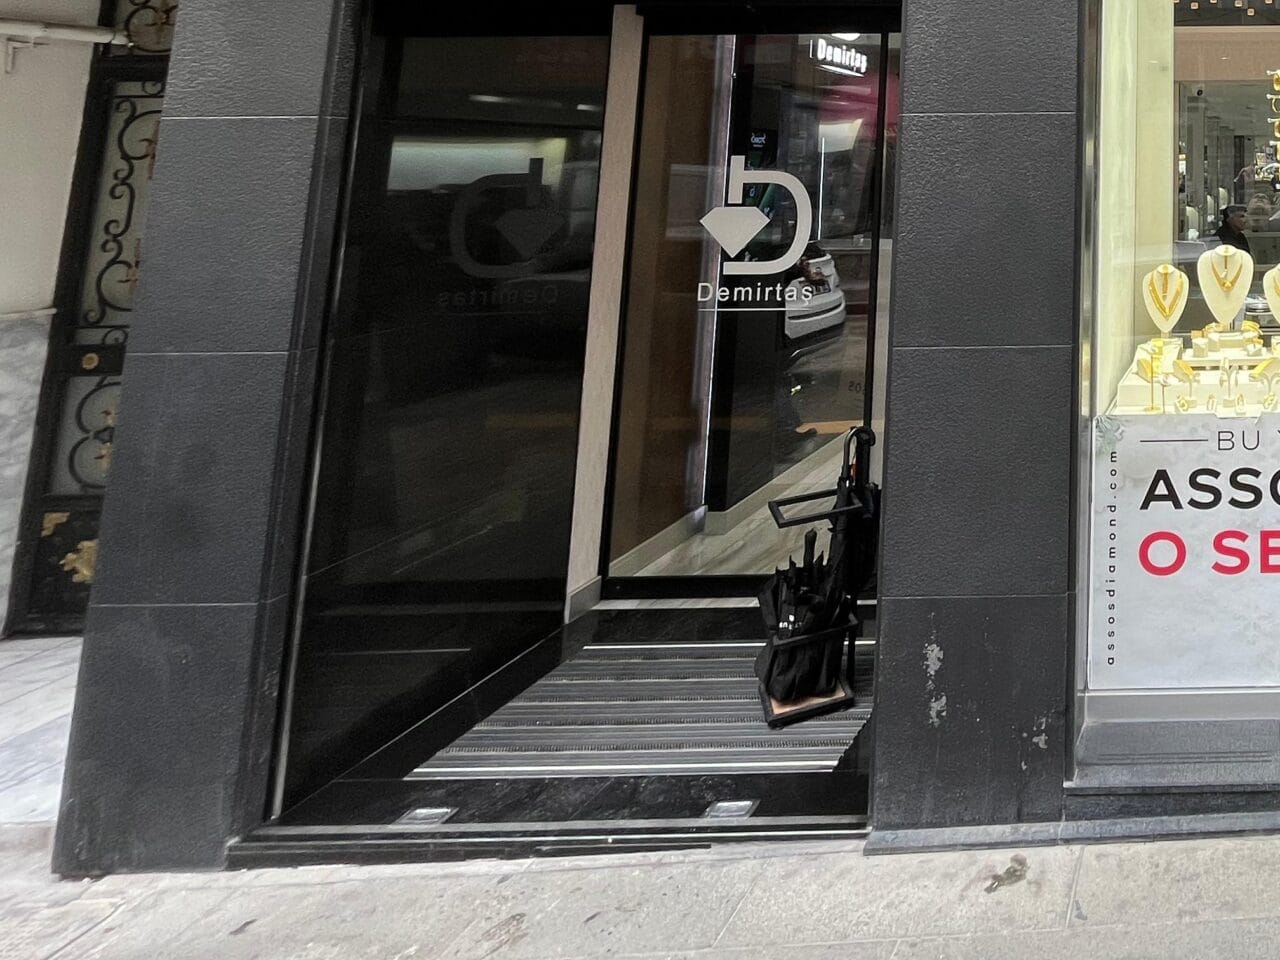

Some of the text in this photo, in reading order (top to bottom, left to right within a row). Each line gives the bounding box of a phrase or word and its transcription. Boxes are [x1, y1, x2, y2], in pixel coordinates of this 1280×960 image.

[1217, 430, 1260, 451] BU
[1106, 451, 1118, 665] assosdiamond.com
[1138, 531, 1187, 576] O
